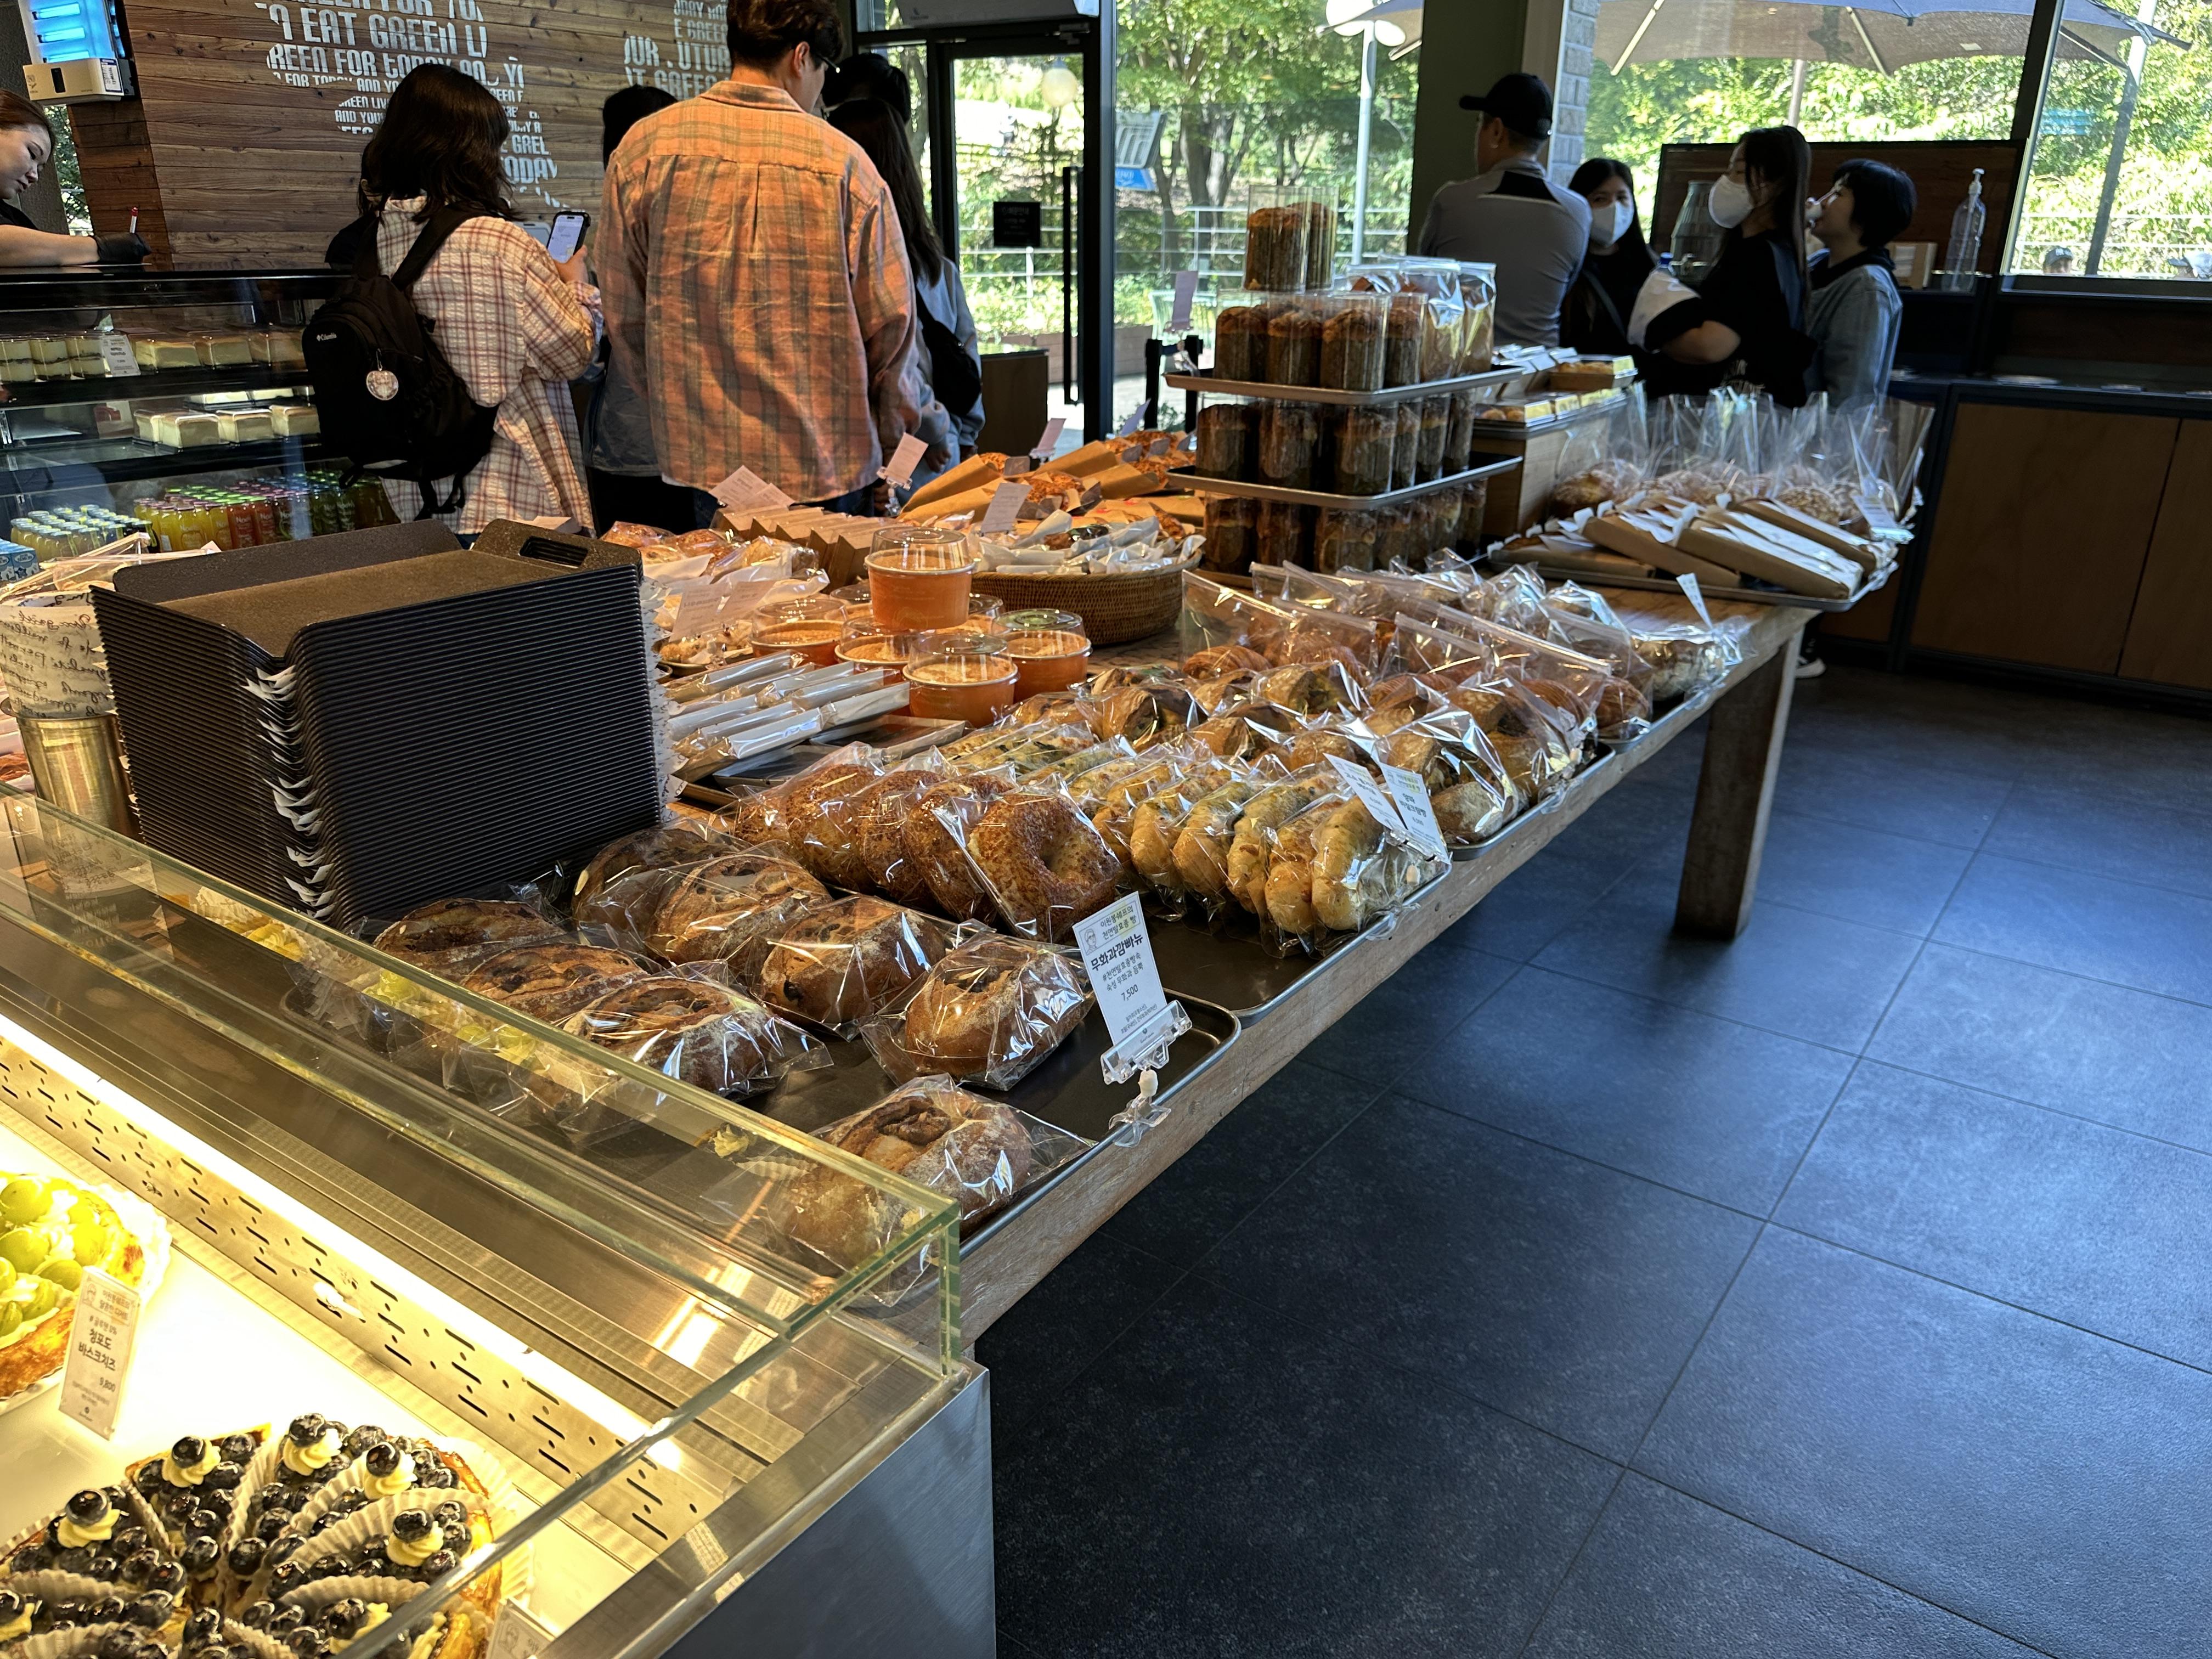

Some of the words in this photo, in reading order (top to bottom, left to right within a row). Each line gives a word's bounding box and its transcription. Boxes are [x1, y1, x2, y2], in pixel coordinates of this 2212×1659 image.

[301, 8, 357, 46] EAT
[368, 14, 458, 54] GREEN
[334, 49, 377, 77] FOR
[357, 78, 381, 93] AND
[335, 110, 357, 123] AND
[500, 156, 558, 184] ODAY
[1091, 934, 1143, 971] 무화과깜빠뉴
[1117, 969, 1133, 985] 무화과
[1121, 984, 1138, 1001] 7,500
[89, 1328, 112, 1350] 청포도
[78, 1341, 116, 1372] 바스크치즈
